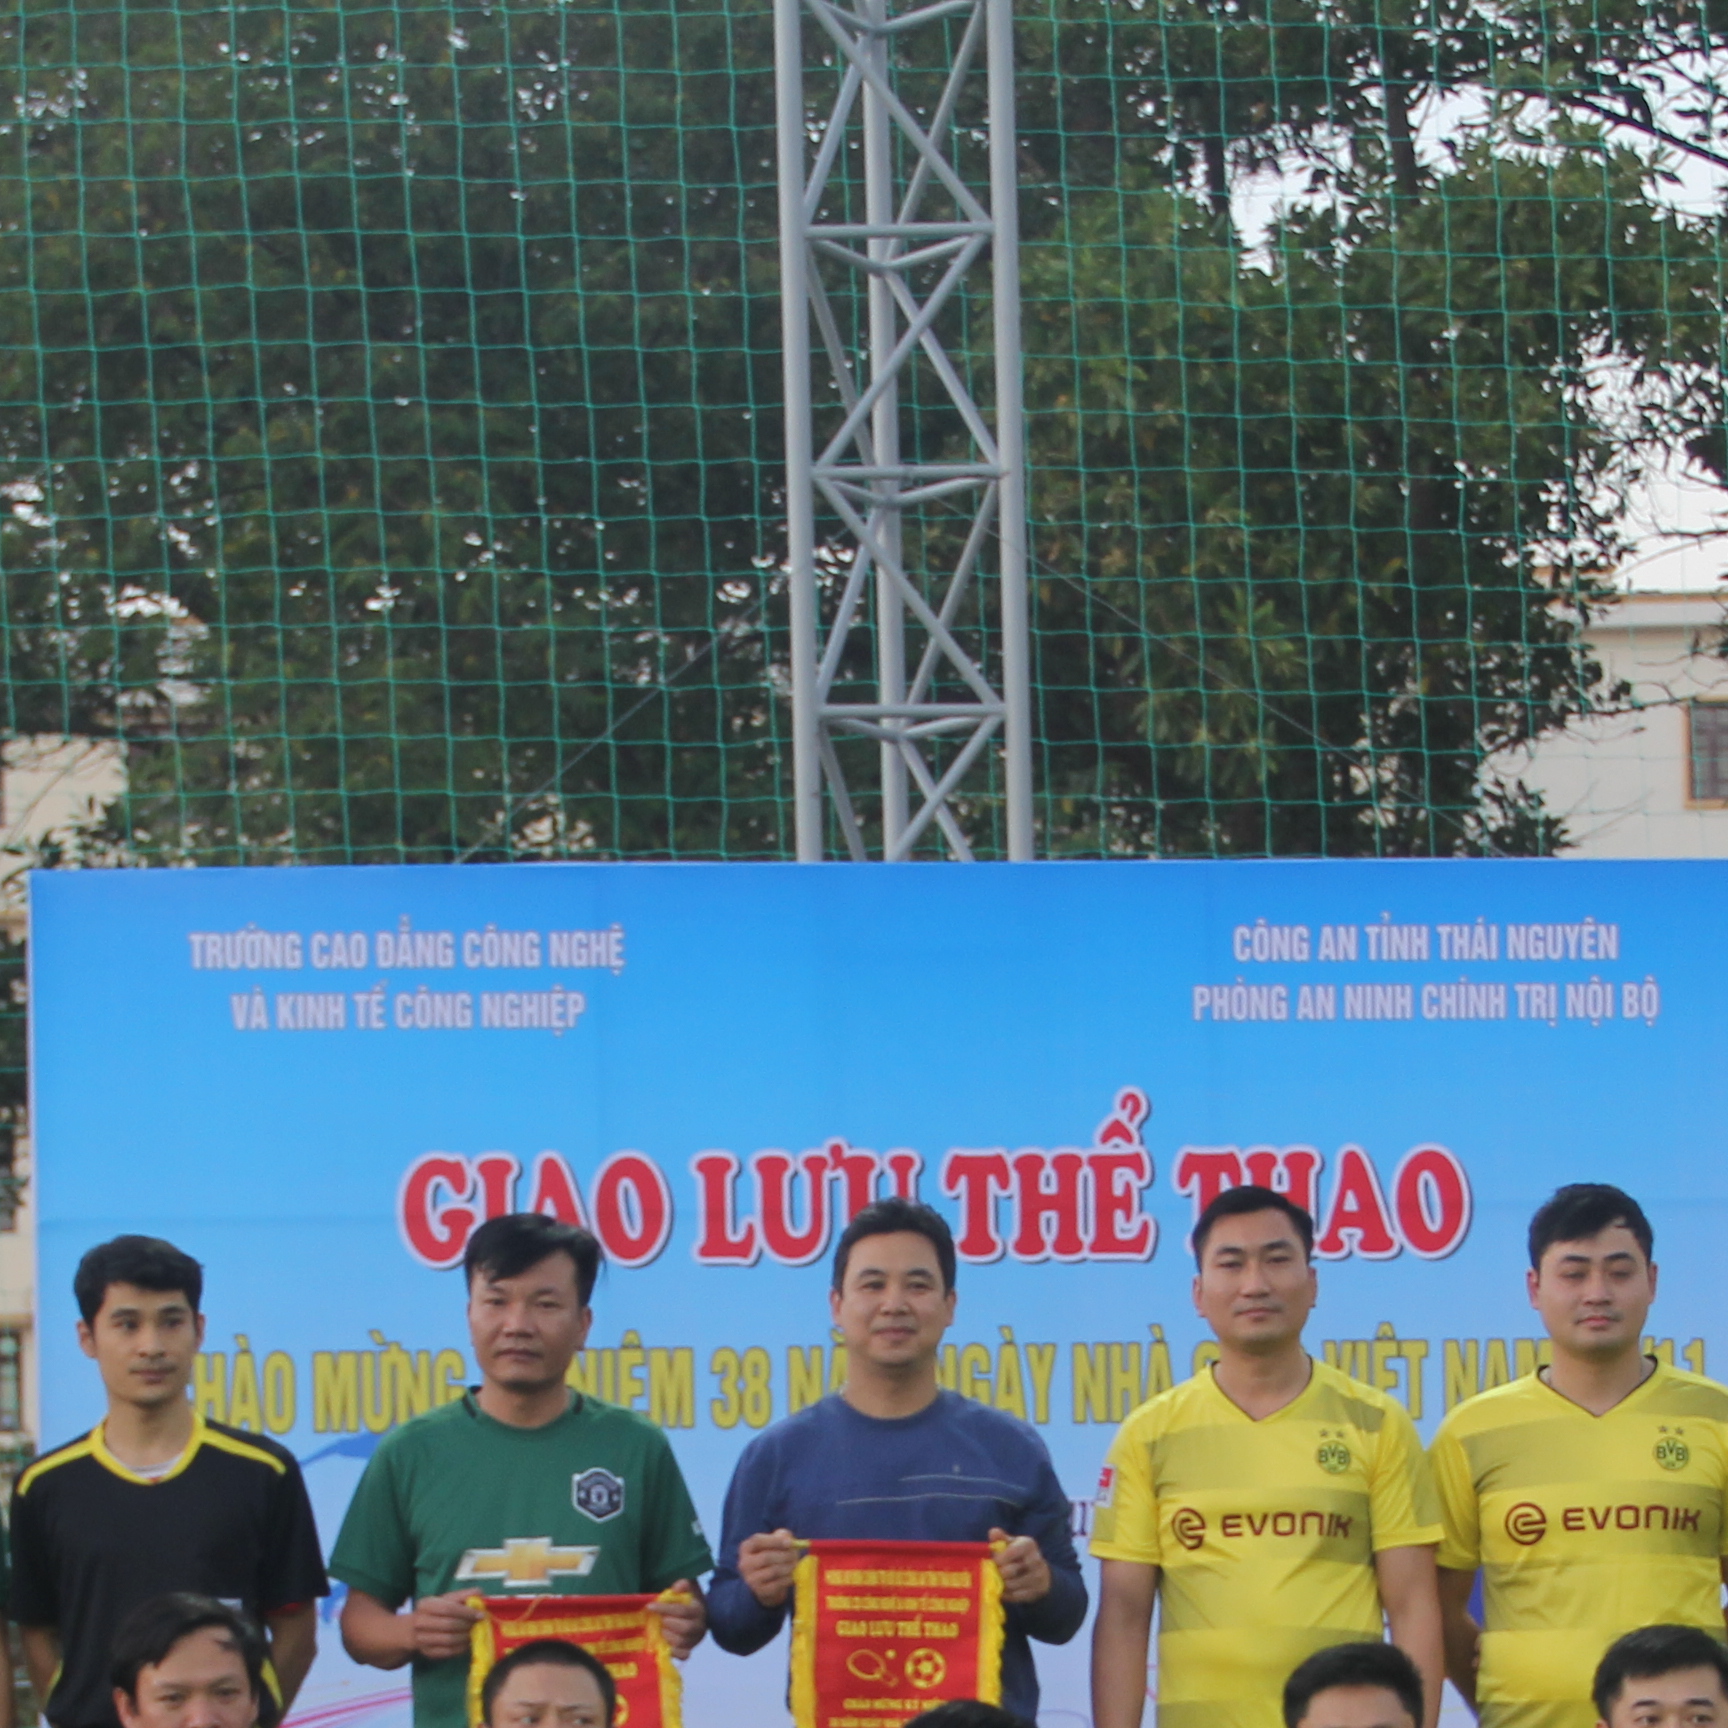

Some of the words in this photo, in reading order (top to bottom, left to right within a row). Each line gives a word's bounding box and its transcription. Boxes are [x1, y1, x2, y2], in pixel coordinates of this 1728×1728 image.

[188, 922, 303, 970] TRƯỜNG
[311, 931, 368, 970] CAO
[375, 914, 454, 970] ĐẲNG
[463, 922, 541, 969] CÔNG
[549, 923, 626, 976] NGHỆ
[1233, 917, 1310, 962] CÔNG
[1318, 925, 1358, 962] AN
[1366, 911, 1430, 961] TỈNH
[1437, 916, 1498, 961] THÁI
[1507, 916, 1619, 961] NGUYÊN
[230, 985, 268, 1031] VÀ
[276, 993, 346, 1031] KINH
[354, 978, 388, 1030] TẾ
[395, 984, 472, 1030] CÔNG
[481, 983, 586, 1037] NGHIỆP
[1193, 976, 1288, 1021] PHÒNG
[1297, 984, 1336, 1021] AN
[1344, 983, 1414, 1020] NINH
[1422, 975, 1506, 1020] CHÍNH
[1515, 982, 1557, 1027] TRỊ
[1566, 975, 1614, 1027] NỘI
[1622, 975, 1659, 1027] BỘ
[399, 1151, 671, 1266] GIAO
[941, 1085, 1156, 1262] THỂ
[192, 1334, 296, 1434] HÀO
[710, 1346, 772, 1429] 38
[1072, 1323, 1173, 1423] NHÀ
[1318, 1445, 1351, 1465] BVB
[1656, 1438, 1690, 1461] BVB
[1221, 1511, 1352, 1538] EVONIK
[1562, 1504, 1701, 1532] EVONIK
